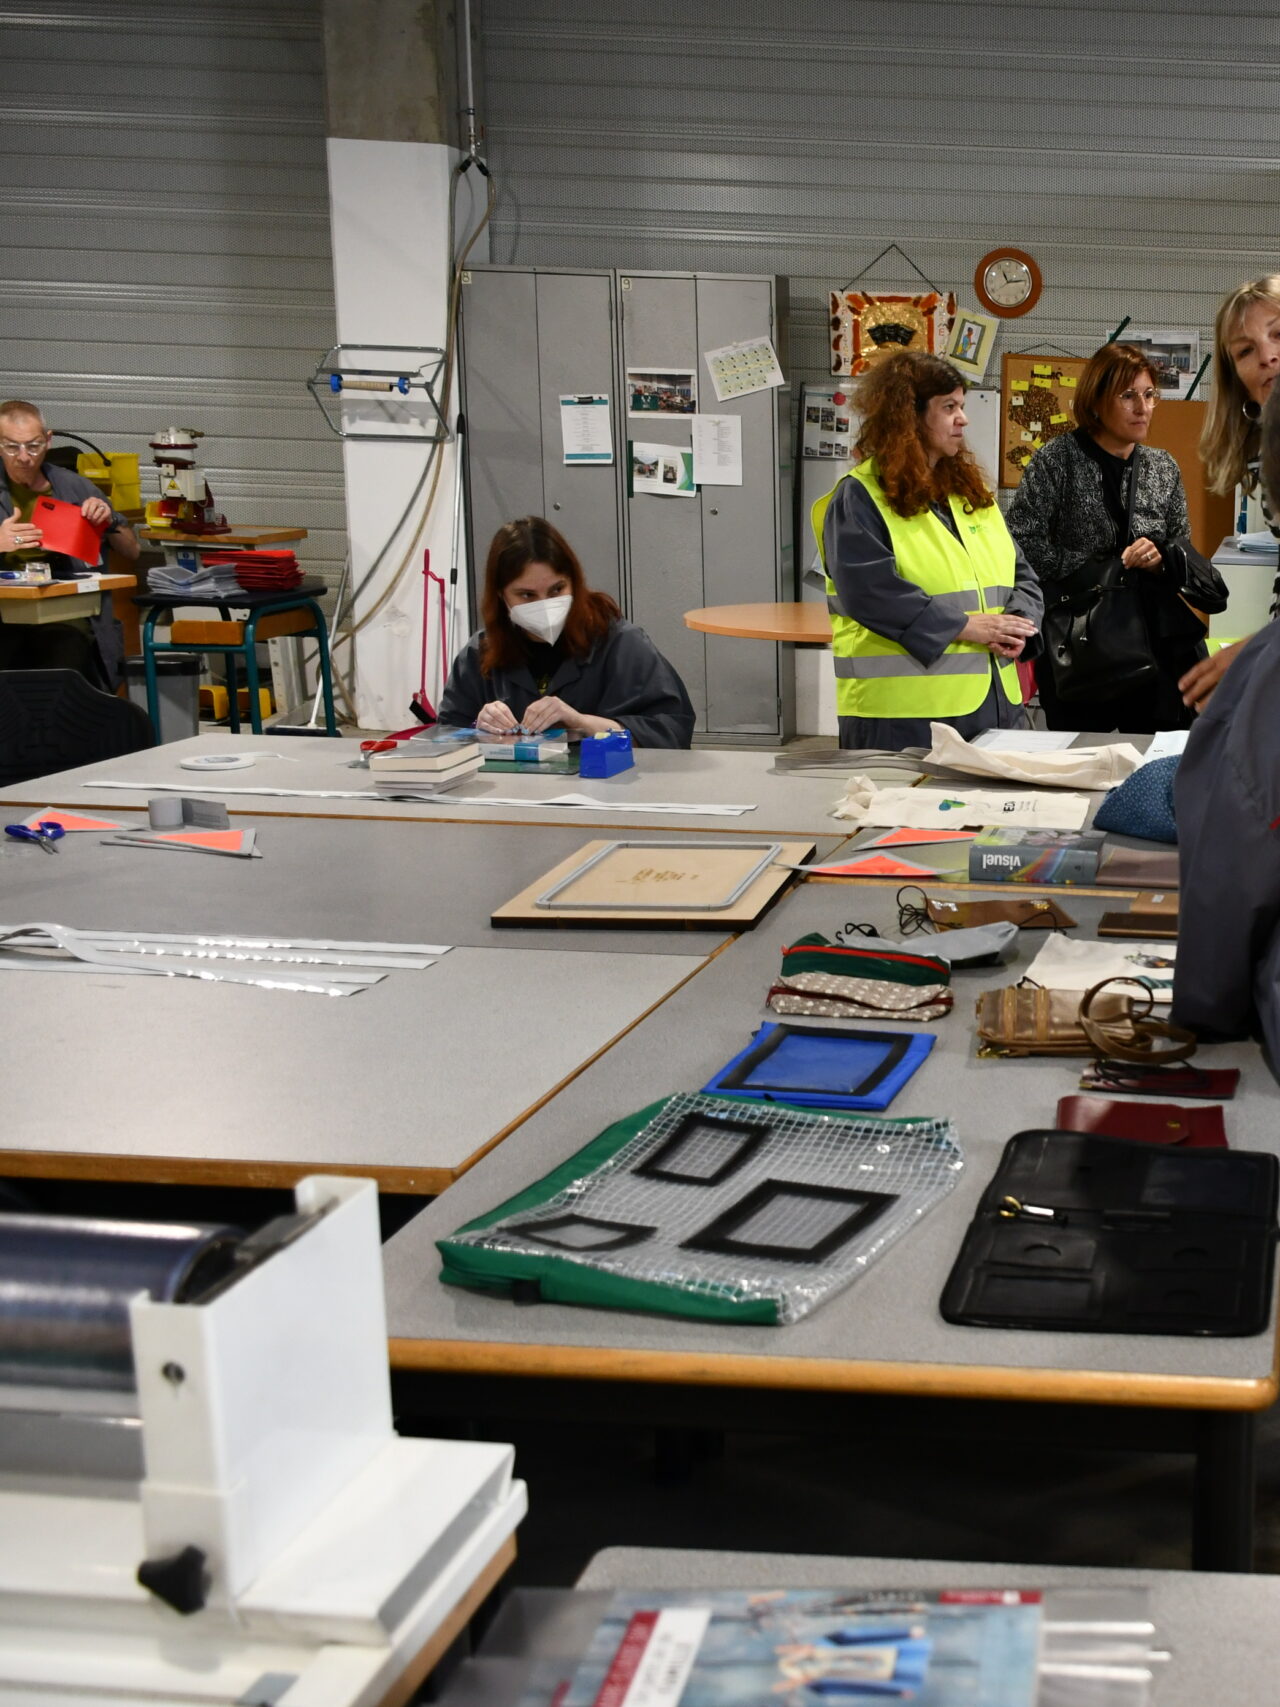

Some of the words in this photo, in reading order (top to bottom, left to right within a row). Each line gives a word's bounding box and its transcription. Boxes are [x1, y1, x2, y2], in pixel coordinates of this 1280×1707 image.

[462, 271, 470, 283] 8
[623, 279, 631, 290] 9
[982, 854, 1021, 870] visuel
